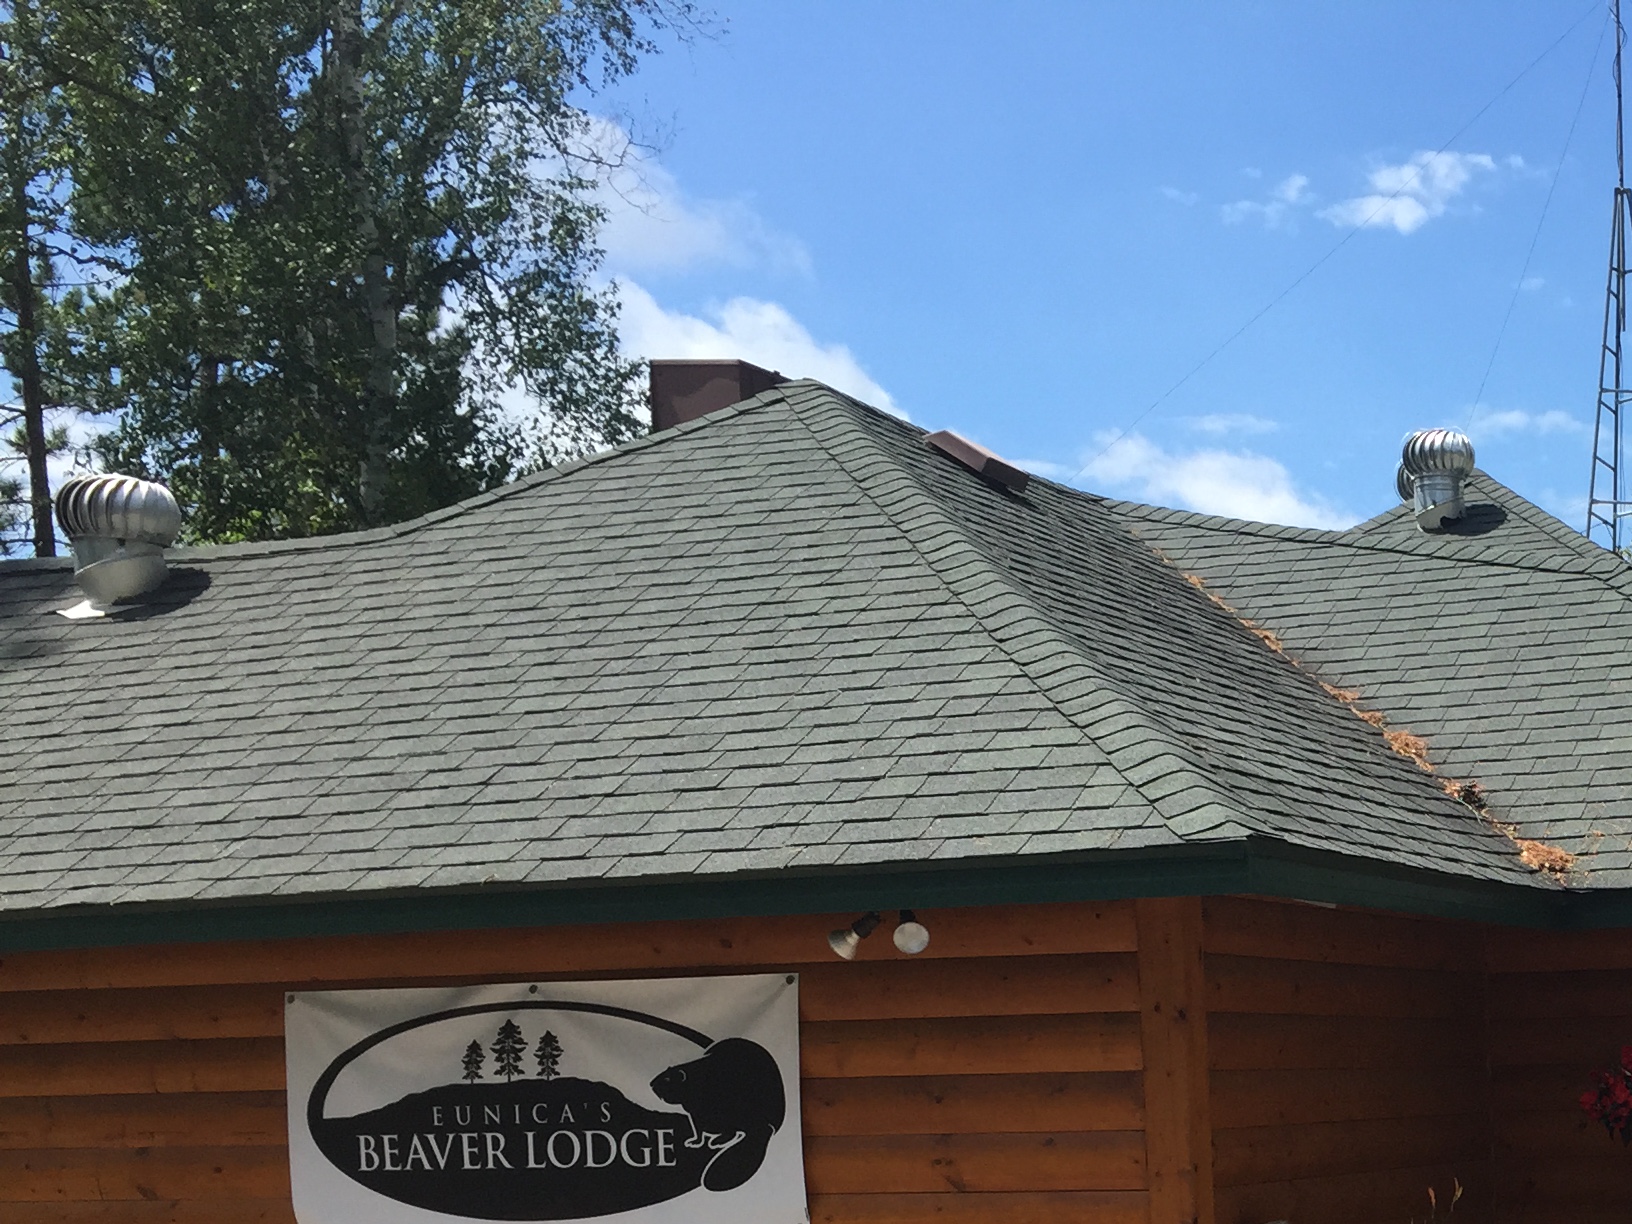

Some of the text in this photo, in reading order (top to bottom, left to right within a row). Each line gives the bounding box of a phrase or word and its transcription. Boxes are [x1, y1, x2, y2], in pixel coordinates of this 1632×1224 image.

[431, 1102, 612, 1126] EUNICA'S
[356, 1128, 678, 1172] BEAVER LODGE
